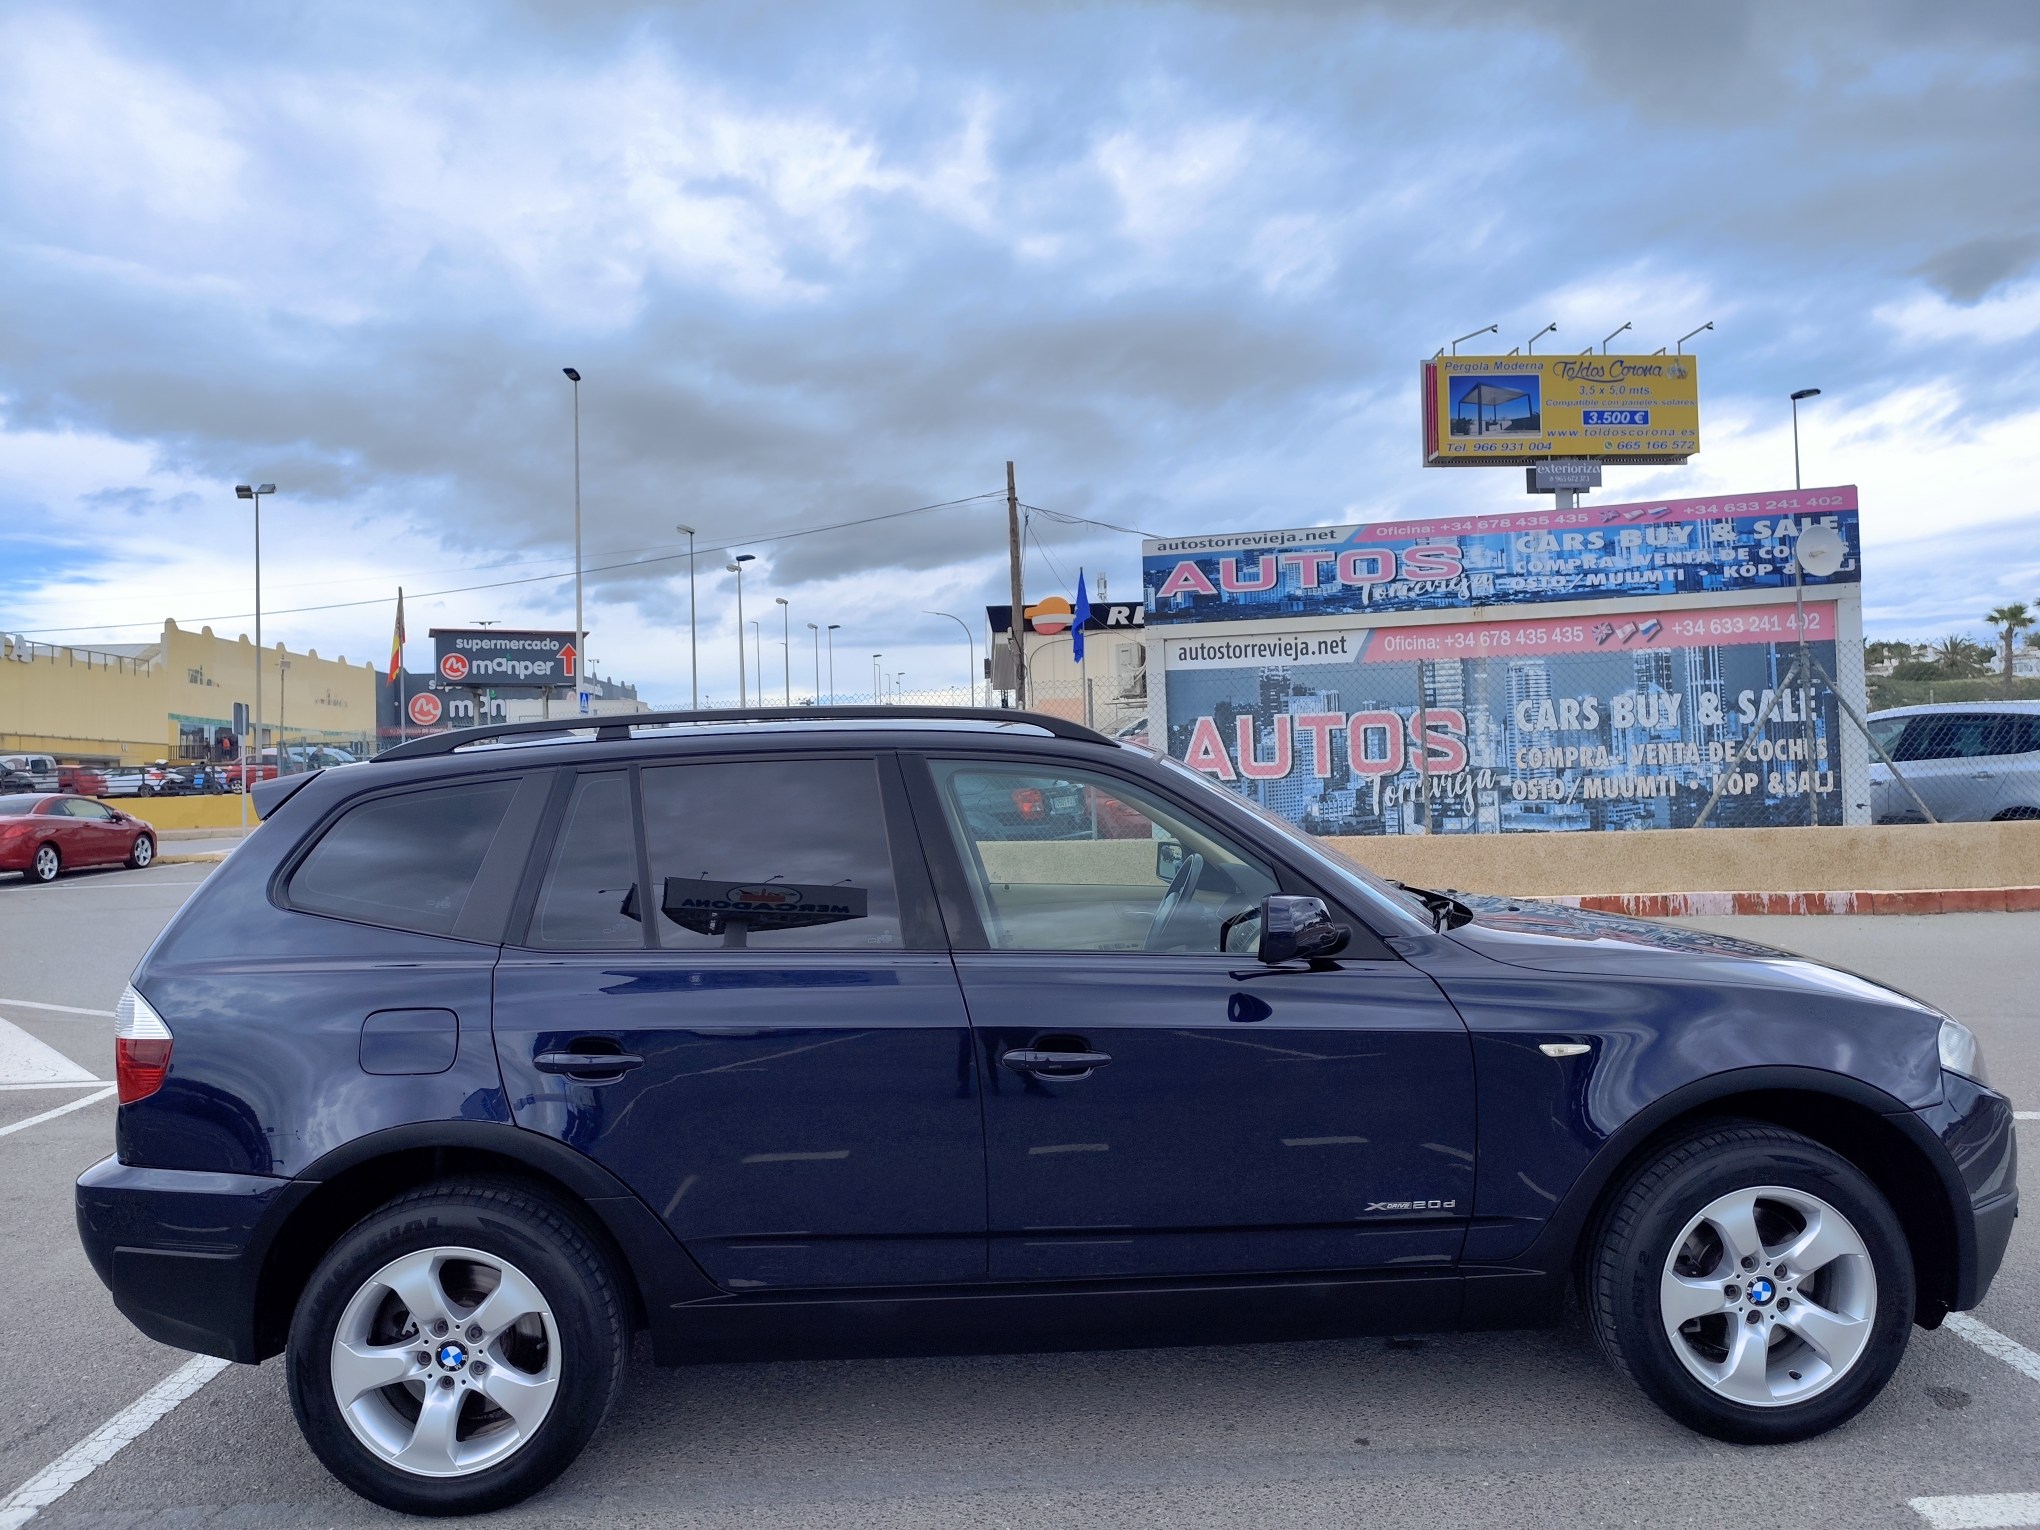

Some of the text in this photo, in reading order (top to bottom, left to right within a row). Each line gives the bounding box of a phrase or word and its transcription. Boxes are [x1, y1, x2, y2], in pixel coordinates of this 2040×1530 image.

[1493, 361, 1544, 371] Moderna
[1553, 360, 1662, 381] Toldos Corona
[1599, 387, 1605, 395] x
[1609, 385, 1626, 395] 5,0
[1545, 398, 1599, 407] Compatible
[1621, 398, 1658, 407] paneles
[1661, 398, 1695, 406] solares
[1588, 412, 1645, 424] 3.500 €
[1547, 427, 1696, 437] www.toldoscorona.es
[1447, 442, 1552, 452] Tel. 966 931 004
[1617, 440, 1695, 450] 665 166 572
[1537, 463, 1601, 474] exterioriza
[1684, 496, 1843, 515] +34 633 241 402
[1376, 513, 1589, 537] Oficina: +34 678 435 435
[1157, 529, 1337, 552] autostorrevieja.net
[1516, 531, 1605, 554] CARS
[1619, 525, 1695, 548] BUY
[1711, 522, 1738, 542] &
[1515, 555, 1615, 574] COMPRA
[1637, 547, 1713, 567] VENTA
[1720, 548, 1750, 561] DE
[1723, 561, 1773, 578] KÖP
[1156, 545, 1465, 599] AUTOS
[1360, 573, 1493, 606] Torrevieja
[1672, 619, 1705, 636] +34
[1710, 617, 1744, 635] 633
[1749, 615, 1782, 632] 241
[455, 638, 560, 652] supermercado
[1178, 635, 1348, 662] autostorrevieja.net
[1384, 626, 1584, 651] Oficina: +34 678 435 435
[472, 657, 554, 680] manper
[1515, 696, 1600, 732] CARS
[1612, 693, 1683, 729] BUY
[1698, 691, 1724, 726] &
[1184, 708, 1468, 781] AUTOS
[1515, 745, 1610, 770] COMPRA
[1631, 742, 1701, 766] VENTA
[1709, 741, 1736, 763] DE
